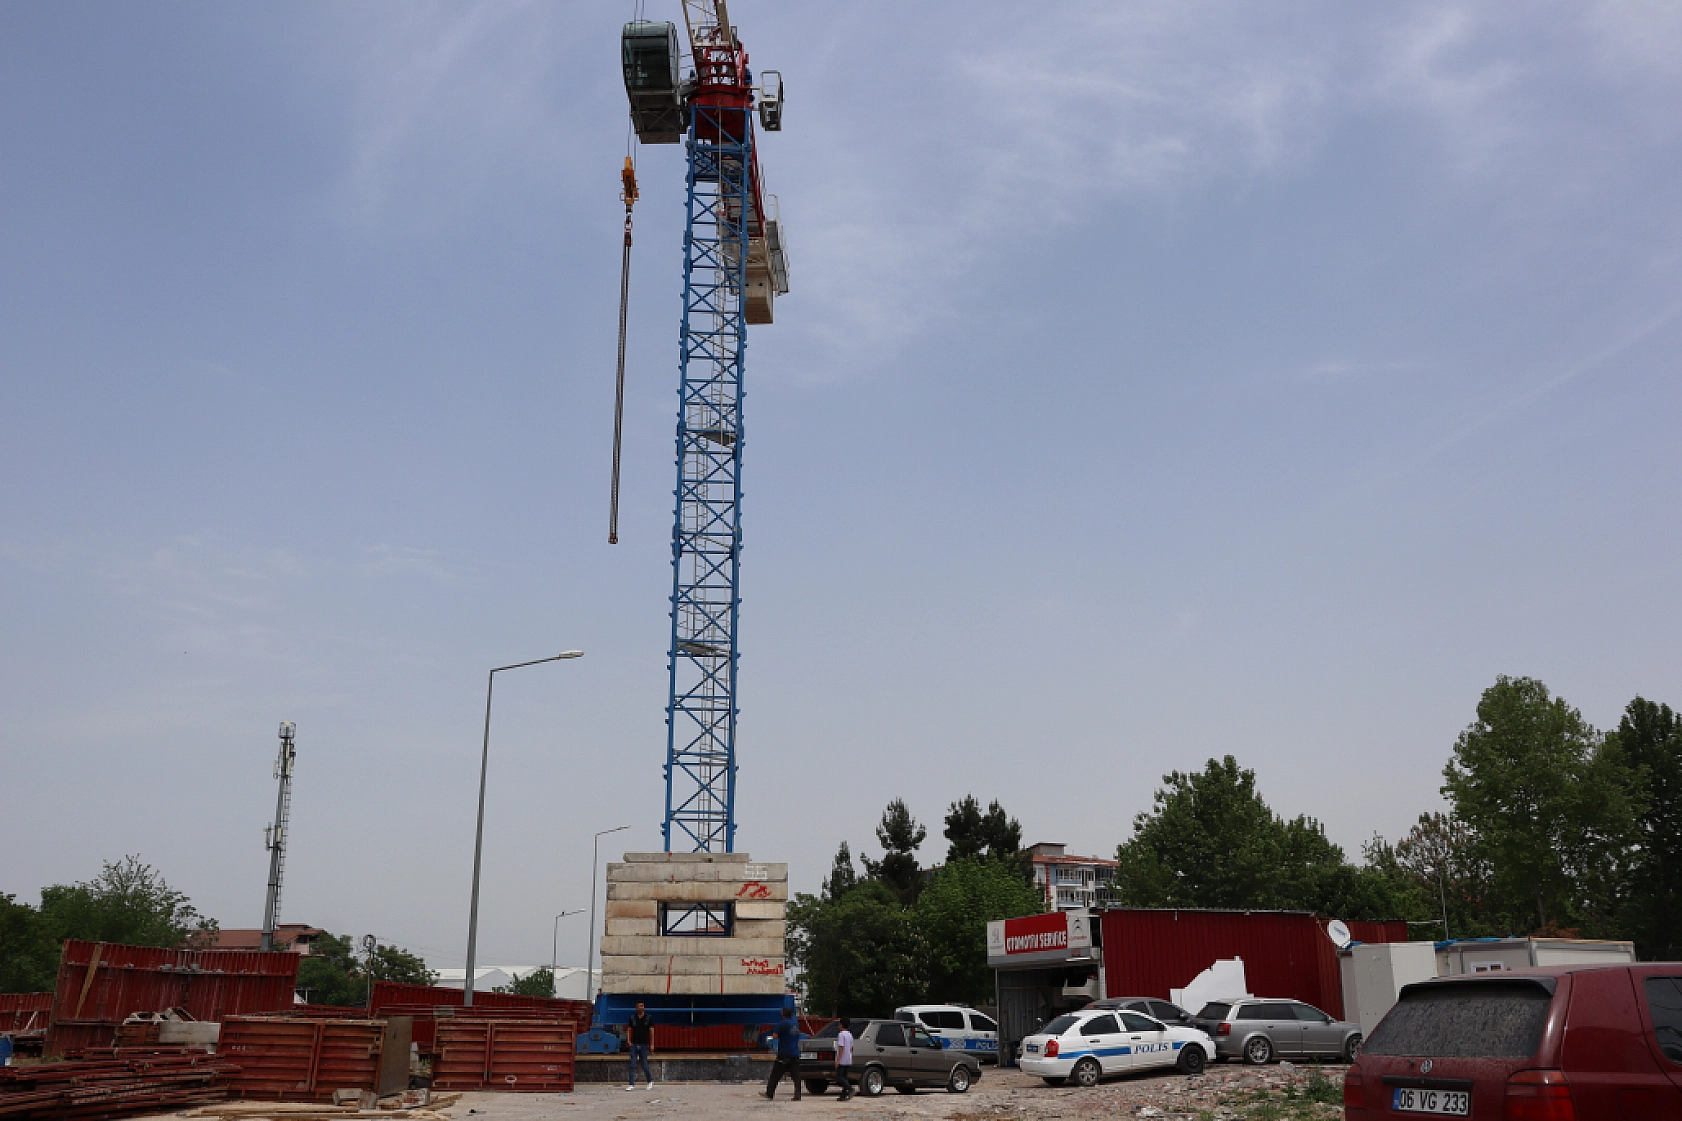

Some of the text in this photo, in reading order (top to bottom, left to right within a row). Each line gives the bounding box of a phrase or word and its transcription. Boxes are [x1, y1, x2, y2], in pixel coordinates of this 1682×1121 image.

[1400, 1090, 1467, 1113] 06 VG 233
